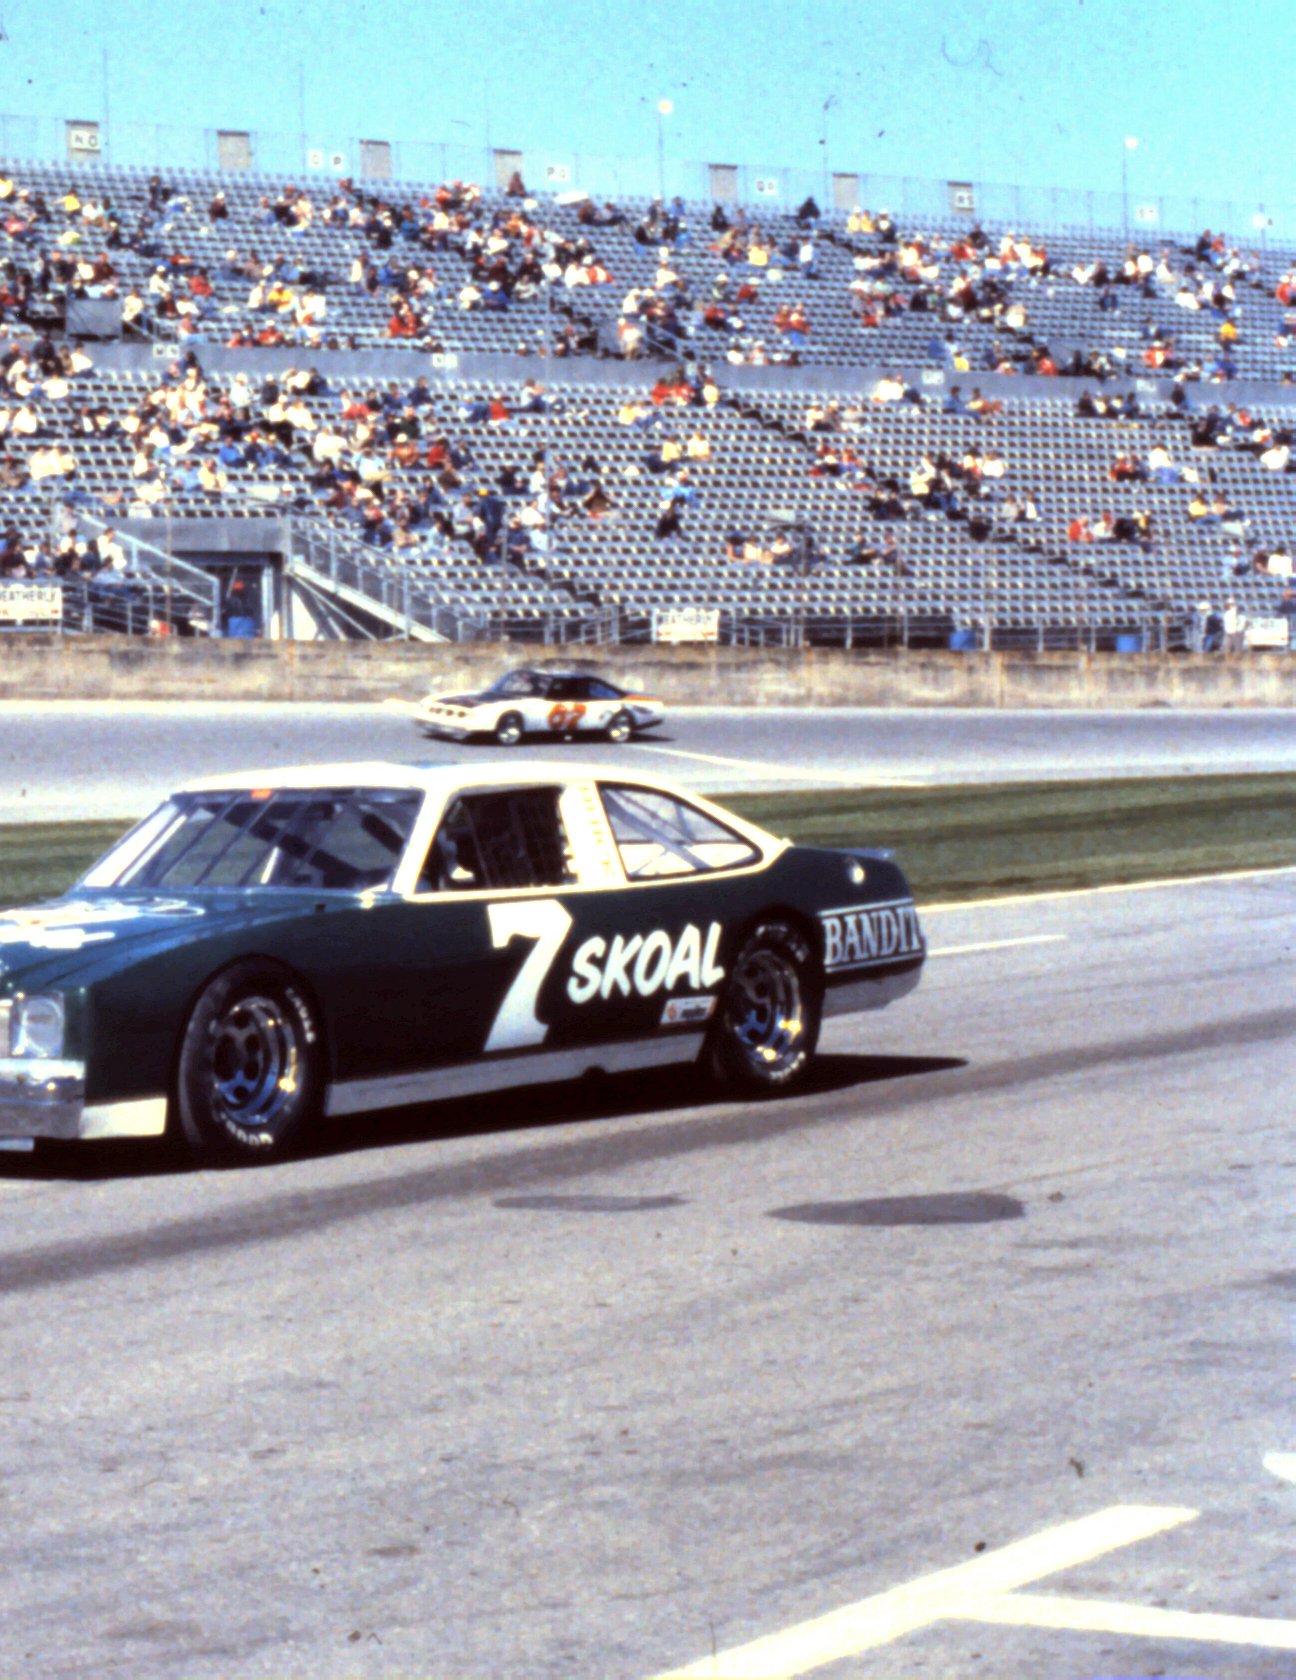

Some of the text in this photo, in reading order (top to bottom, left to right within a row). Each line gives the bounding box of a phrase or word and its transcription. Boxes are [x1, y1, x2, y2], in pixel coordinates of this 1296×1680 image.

[88, 134, 98, 148] O
[567, 921, 725, 1005] SKOAL
[822, 906, 921, 965] BANDIT
[484, 899, 573, 1052] 7
